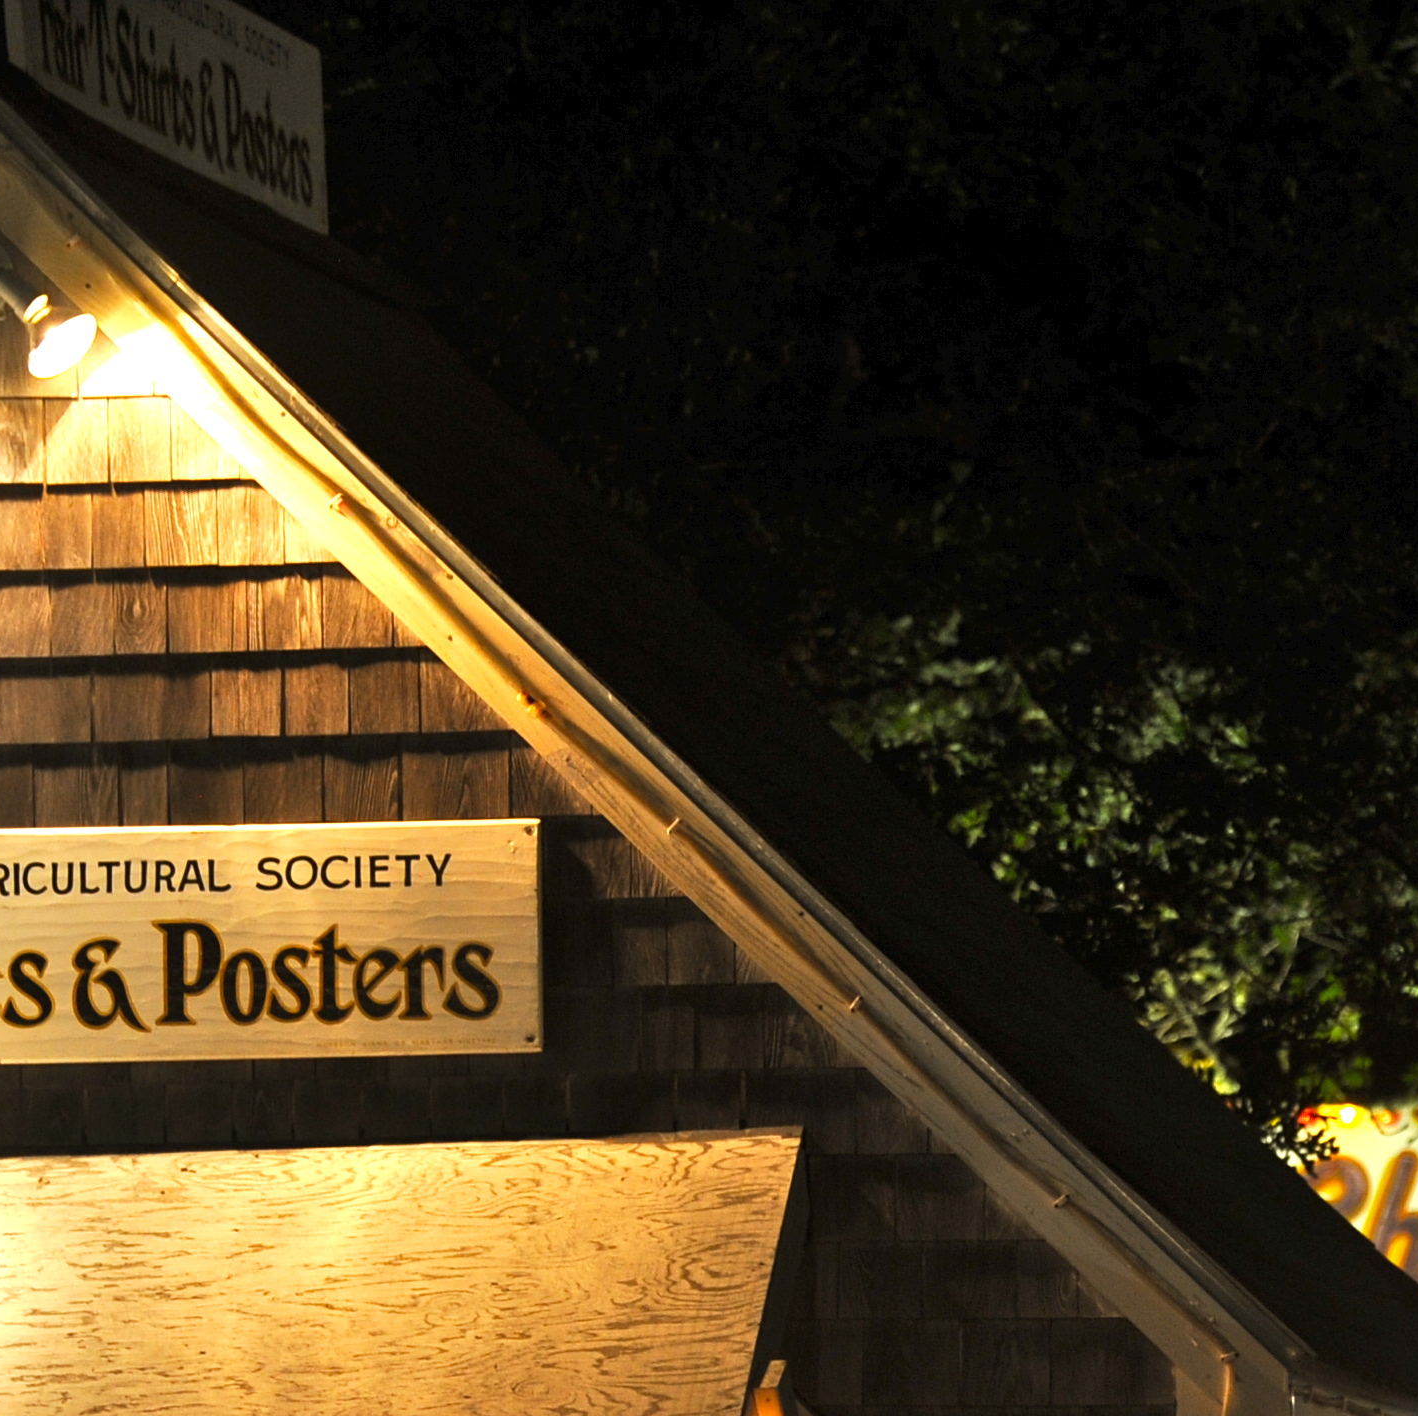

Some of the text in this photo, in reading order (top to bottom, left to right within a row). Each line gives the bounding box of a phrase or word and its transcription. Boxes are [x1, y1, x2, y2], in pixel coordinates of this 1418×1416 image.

[85, 0, 196, 152] T-Shirts
[199, 58, 225, 174] &
[221, 60, 314, 208] Posters
[255, 853, 452, 891] SOCIETY
[72, 936, 152, 1033] &
[150, 920, 503, 1027] Posters
